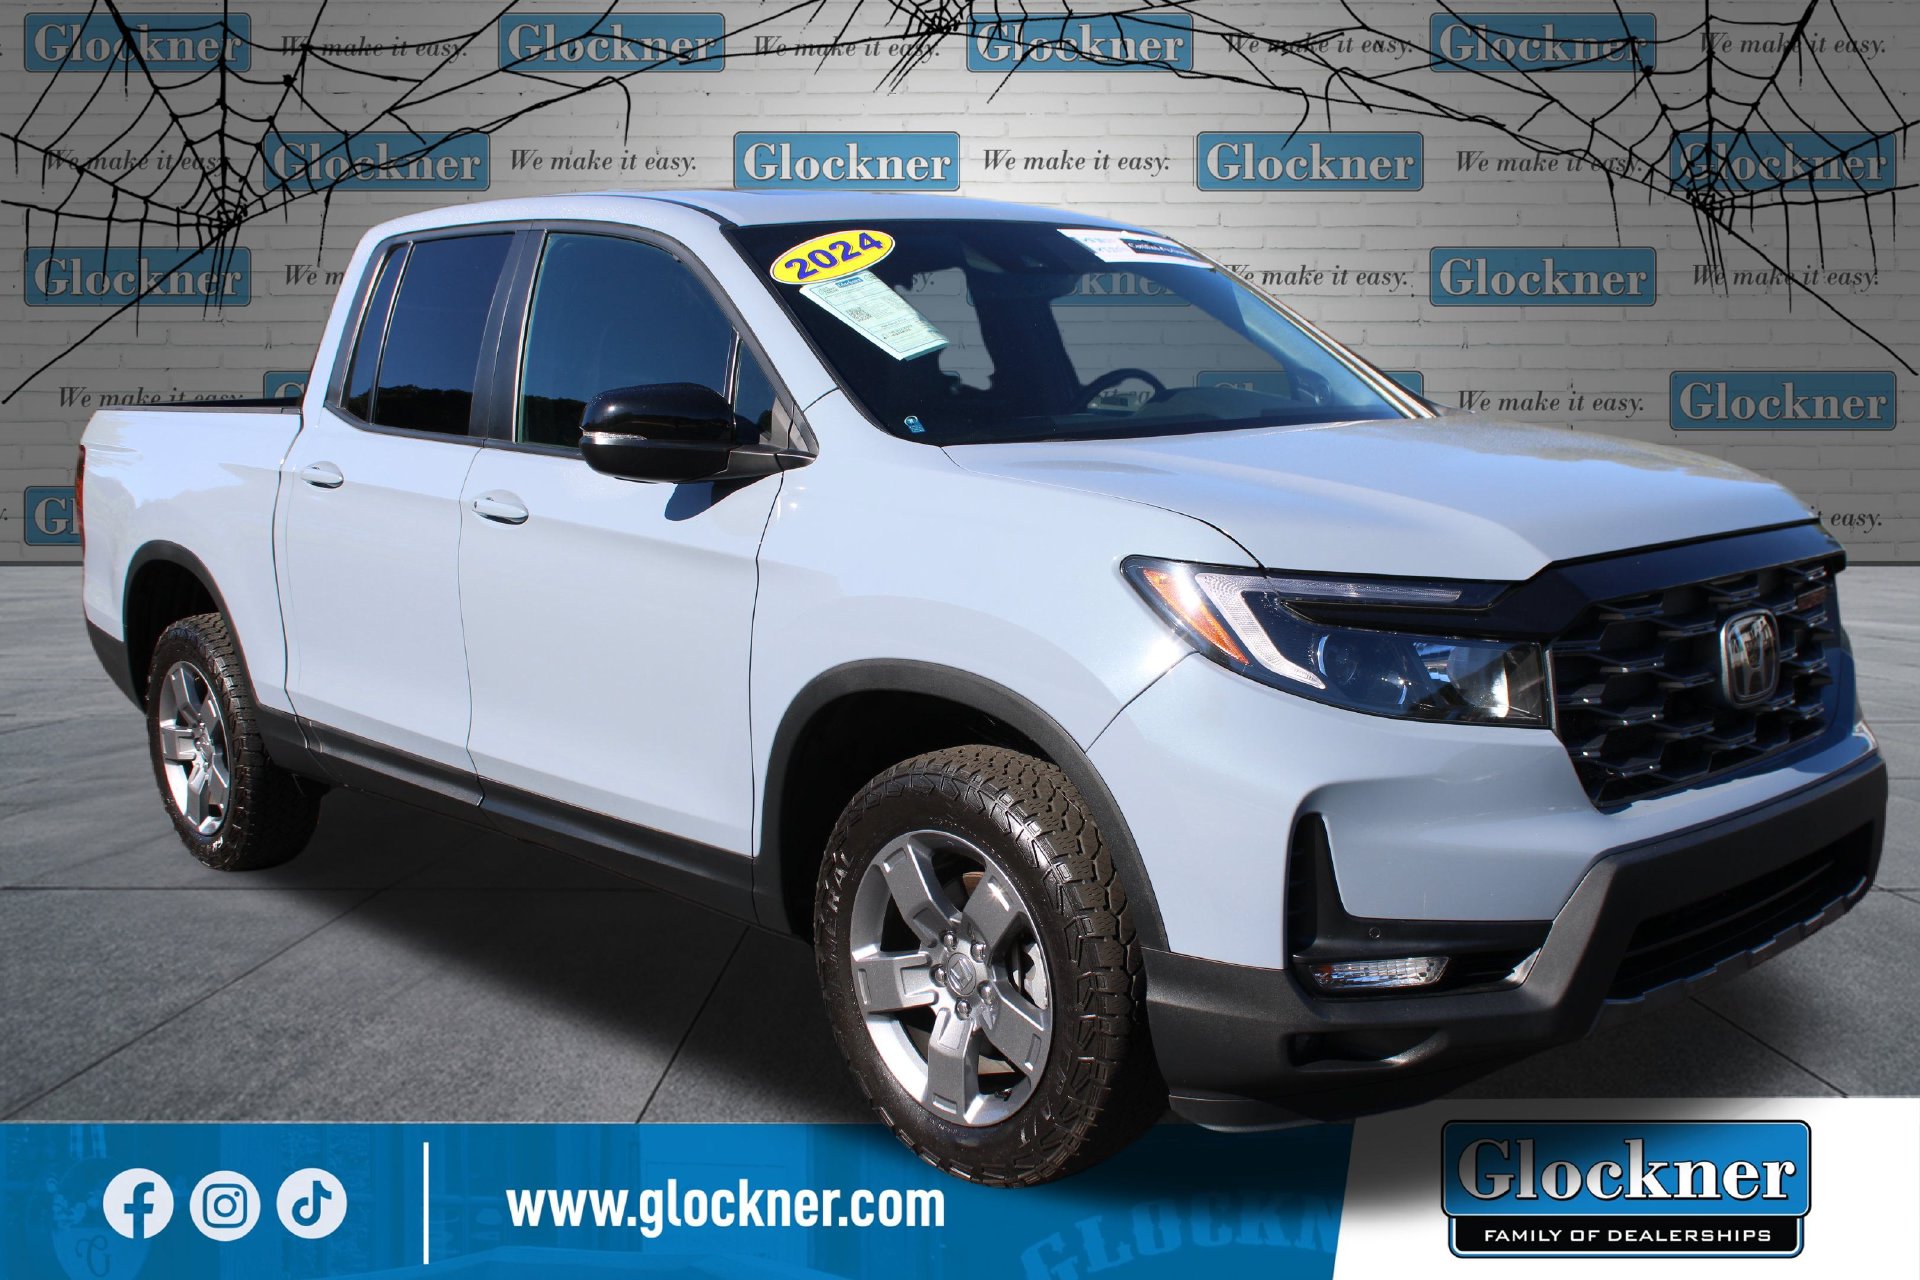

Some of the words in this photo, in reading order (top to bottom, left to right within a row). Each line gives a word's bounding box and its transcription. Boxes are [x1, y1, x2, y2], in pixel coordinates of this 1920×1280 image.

[33, 22, 244, 62] Glockner
[281, 35, 315, 56] W
[322, 35, 384, 56] make
[392, 35, 409, 56] it
[507, 22, 718, 62] Glockner
[754, 36, 788, 57] We
[795, 36, 857, 57] make
[865, 36, 882, 57] it
[975, 22, 1186, 62] Glockner
[1338, 32, 1355, 53] it
[1362, 40, 1414, 60] easy.
[1438, 22, 1649, 62] Glockner
[87, 149, 149, 170] make
[157, 149, 174, 170] it
[272, 141, 483, 181] Glockner
[510, 149, 544, 170] We
[551, 149, 613, 170] make
[621, 149, 638, 170] it
[645, 157, 697, 177] easy.
[742, 141, 953, 181] Glockner
[983, 149, 1017, 170] We
[1024, 149, 1086, 170] make
[1094, 149, 1111, 170] it
[1118, 157, 1170, 177] easy.
[1205, 141, 1416, 181] Glockner
[1456, 151, 1490, 172] We
[1497, 151, 1559, 172] make
[1678, 141, 1889, 181] Glockner
[784, 232, 883, 281] 2024
[33, 256, 244, 296] Glockner
[284, 264, 318, 286] We
[1262, 264, 1324, 285] make
[1332, 264, 1349, 285] it
[1356, 272, 1408, 292] easy.
[1438, 256, 1649, 296] Glockner
[1803, 264, 1820, 285] it
[1827, 272, 1879, 292] easy.
[59, 386, 93, 407] We
[1458, 390, 1492, 411] We
[1499, 390, 1561, 411] make
[1569, 390, 1586, 411] it
[1593, 398, 1645, 418] easy.
[1678, 380, 1889, 420] Glockner
[1831, 512, 1883, 534] easy.
